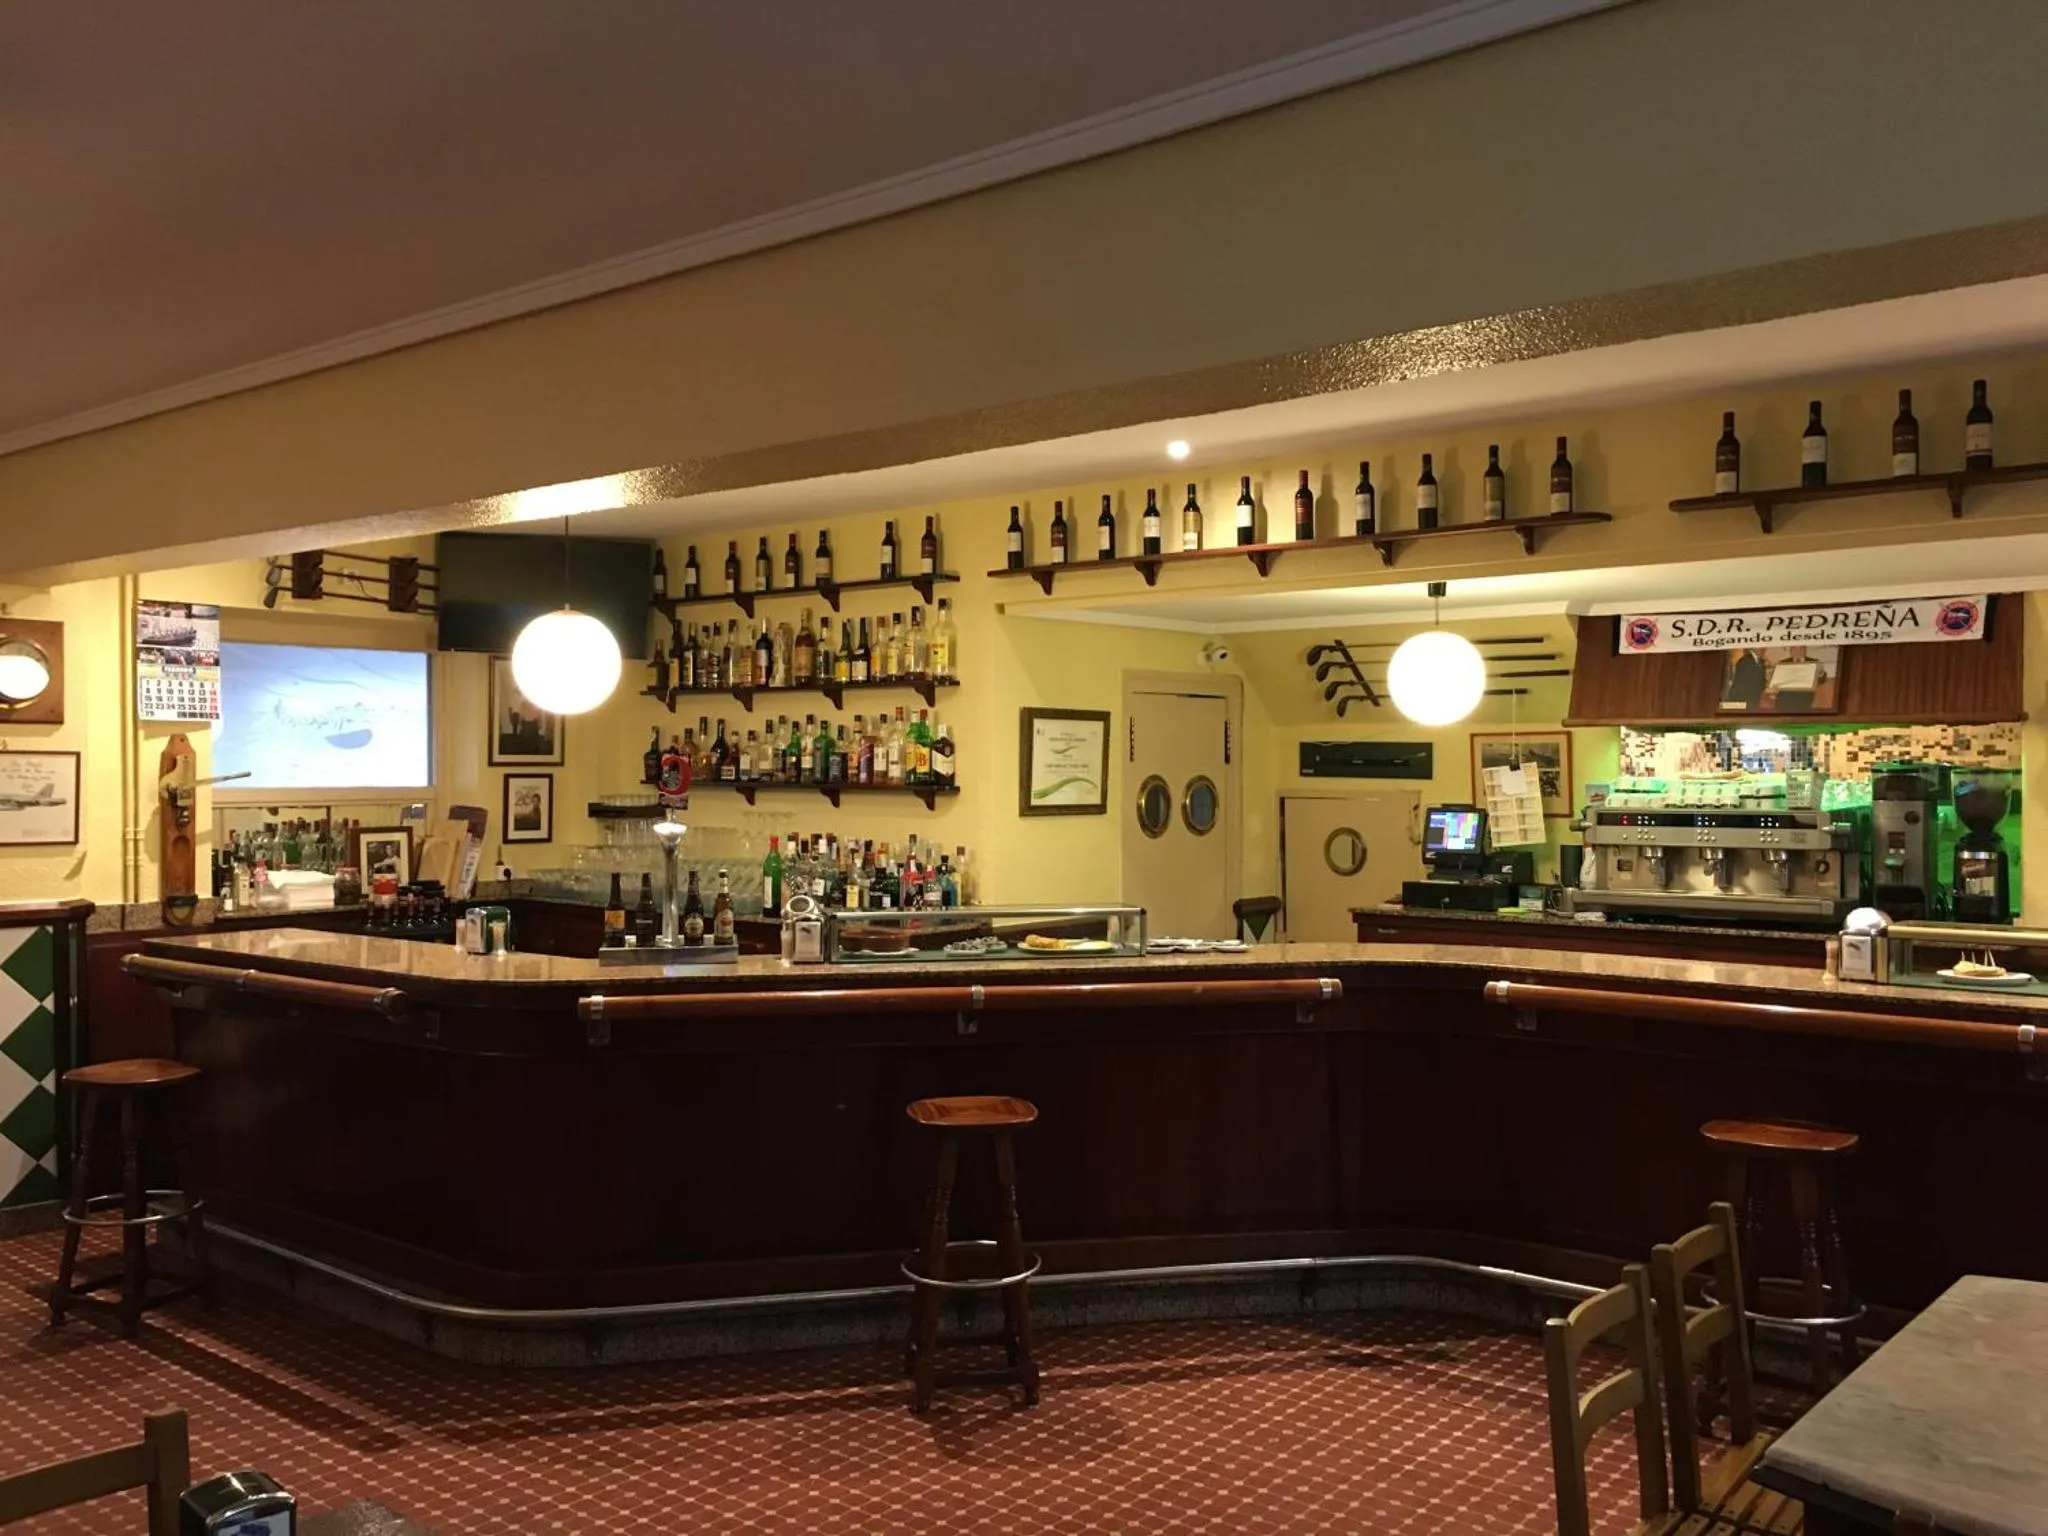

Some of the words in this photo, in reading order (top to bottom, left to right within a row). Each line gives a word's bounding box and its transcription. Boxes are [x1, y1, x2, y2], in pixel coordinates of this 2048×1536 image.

[1671, 617, 1751, 638] S.D.R.
[1766, 604, 1920, 631] PEDREÑA
[1693, 633, 1773, 647] Bogando
[1780, 629, 1837, 641] desde
[1844, 630, 1892, 640] 1895
